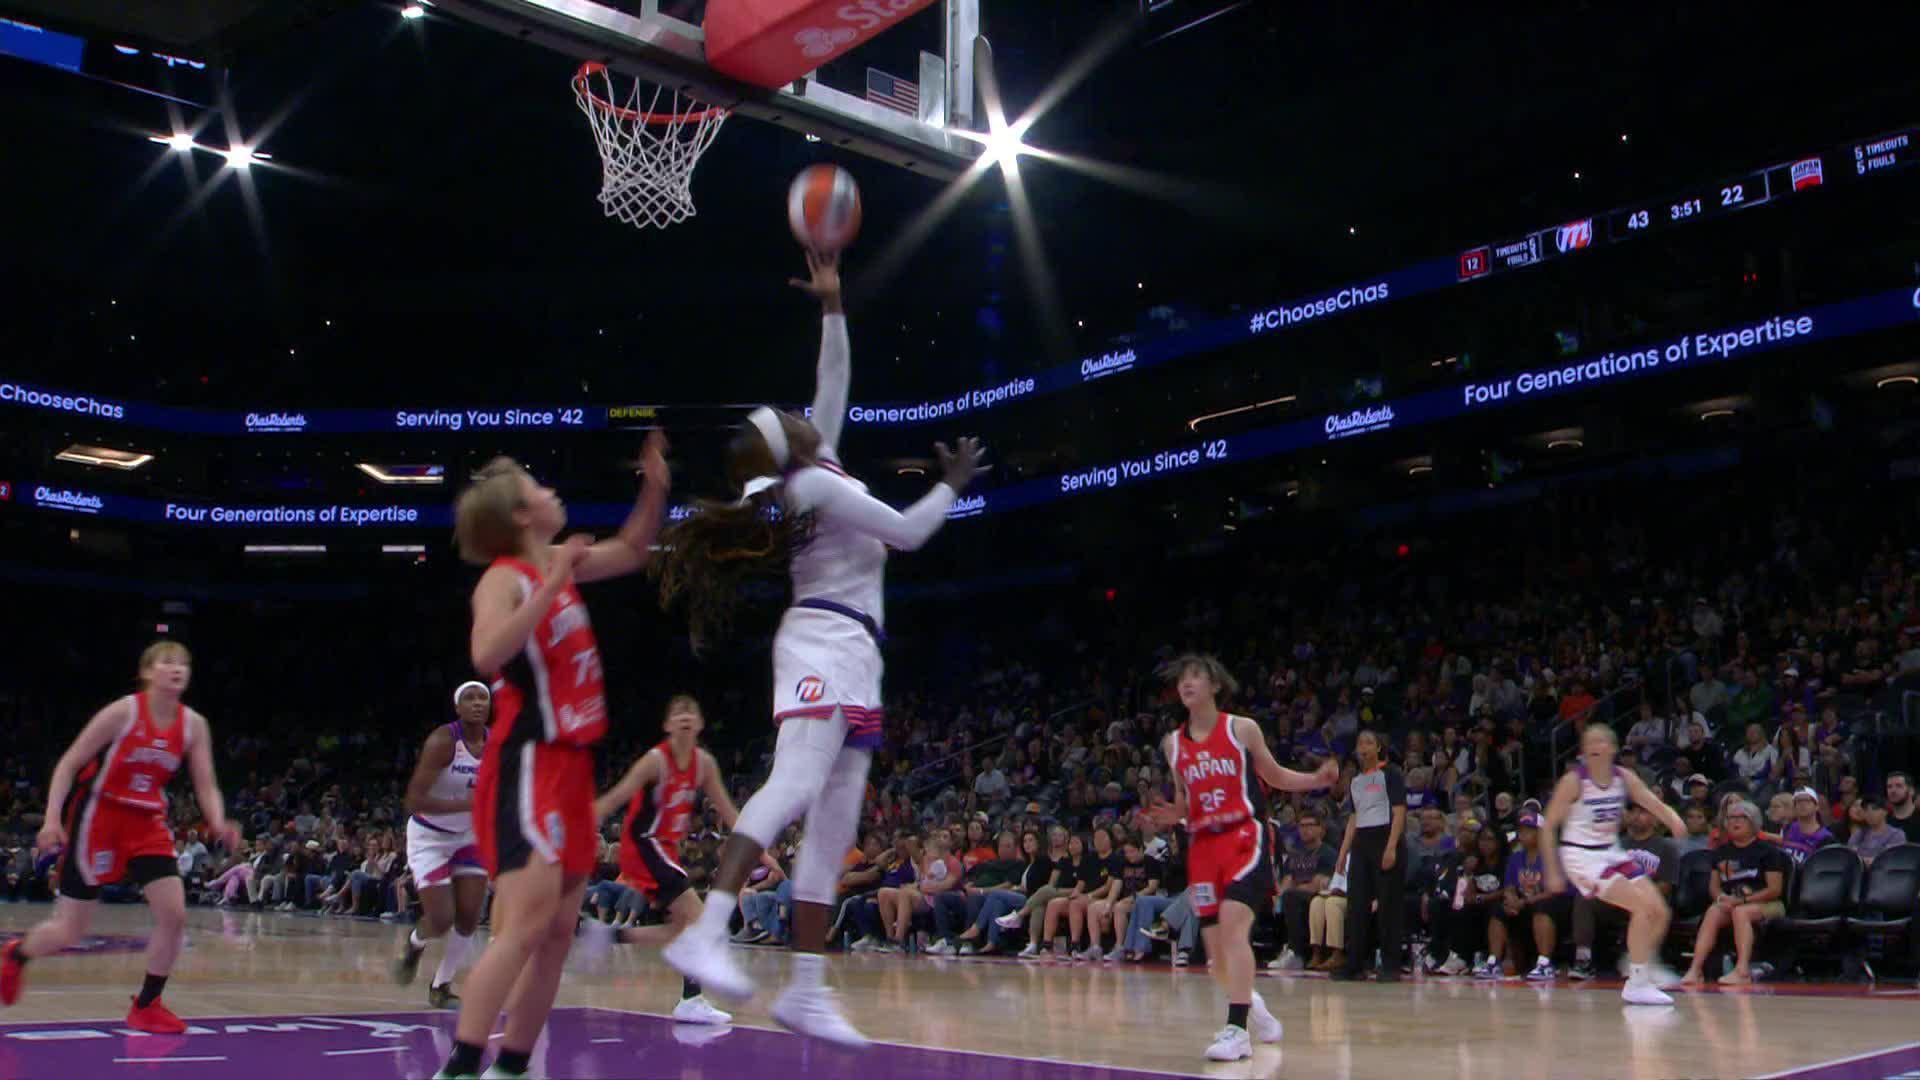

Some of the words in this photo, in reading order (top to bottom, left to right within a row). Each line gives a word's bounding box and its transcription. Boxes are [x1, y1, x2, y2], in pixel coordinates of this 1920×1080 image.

[1866, 135, 1909, 156] TIMEOUTS
[1868, 153, 1896, 171] FOULS
[1628, 211, 1649, 230] 43
[1671, 199, 1702, 219] 3:51
[1721, 185, 1743, 206] 22
[1466, 258, 1480, 272] 12
[1250, 282, 1389, 334] #ChooseChas
[1464, 379, 1511, 406] Four
[1516, 346, 1660, 395] Generations
[1665, 335, 1691, 363] of
[1695, 314, 1814, 359] Expertise
[849, 398, 955, 422] Generations
[957, 393, 971, 409] of
[973, 377, 1035, 408] Expertise
[396, 409, 461, 430] Serving
[467, 410, 500, 425] You
[504, 410, 553, 425] Since
[558, 409, 583, 425] '42
[609, 407, 656, 418] DEFENSE
[1061, 465, 1117, 492] Serving
[1121, 459, 1151, 478] You
[1154, 450, 1200, 472] Since
[1203, 440, 1227, 460] '42
[166, 503, 205, 521] Four
[211, 506, 314, 523] Generations
[319, 505, 336, 522] of
[340, 506, 418, 527] Expertise
